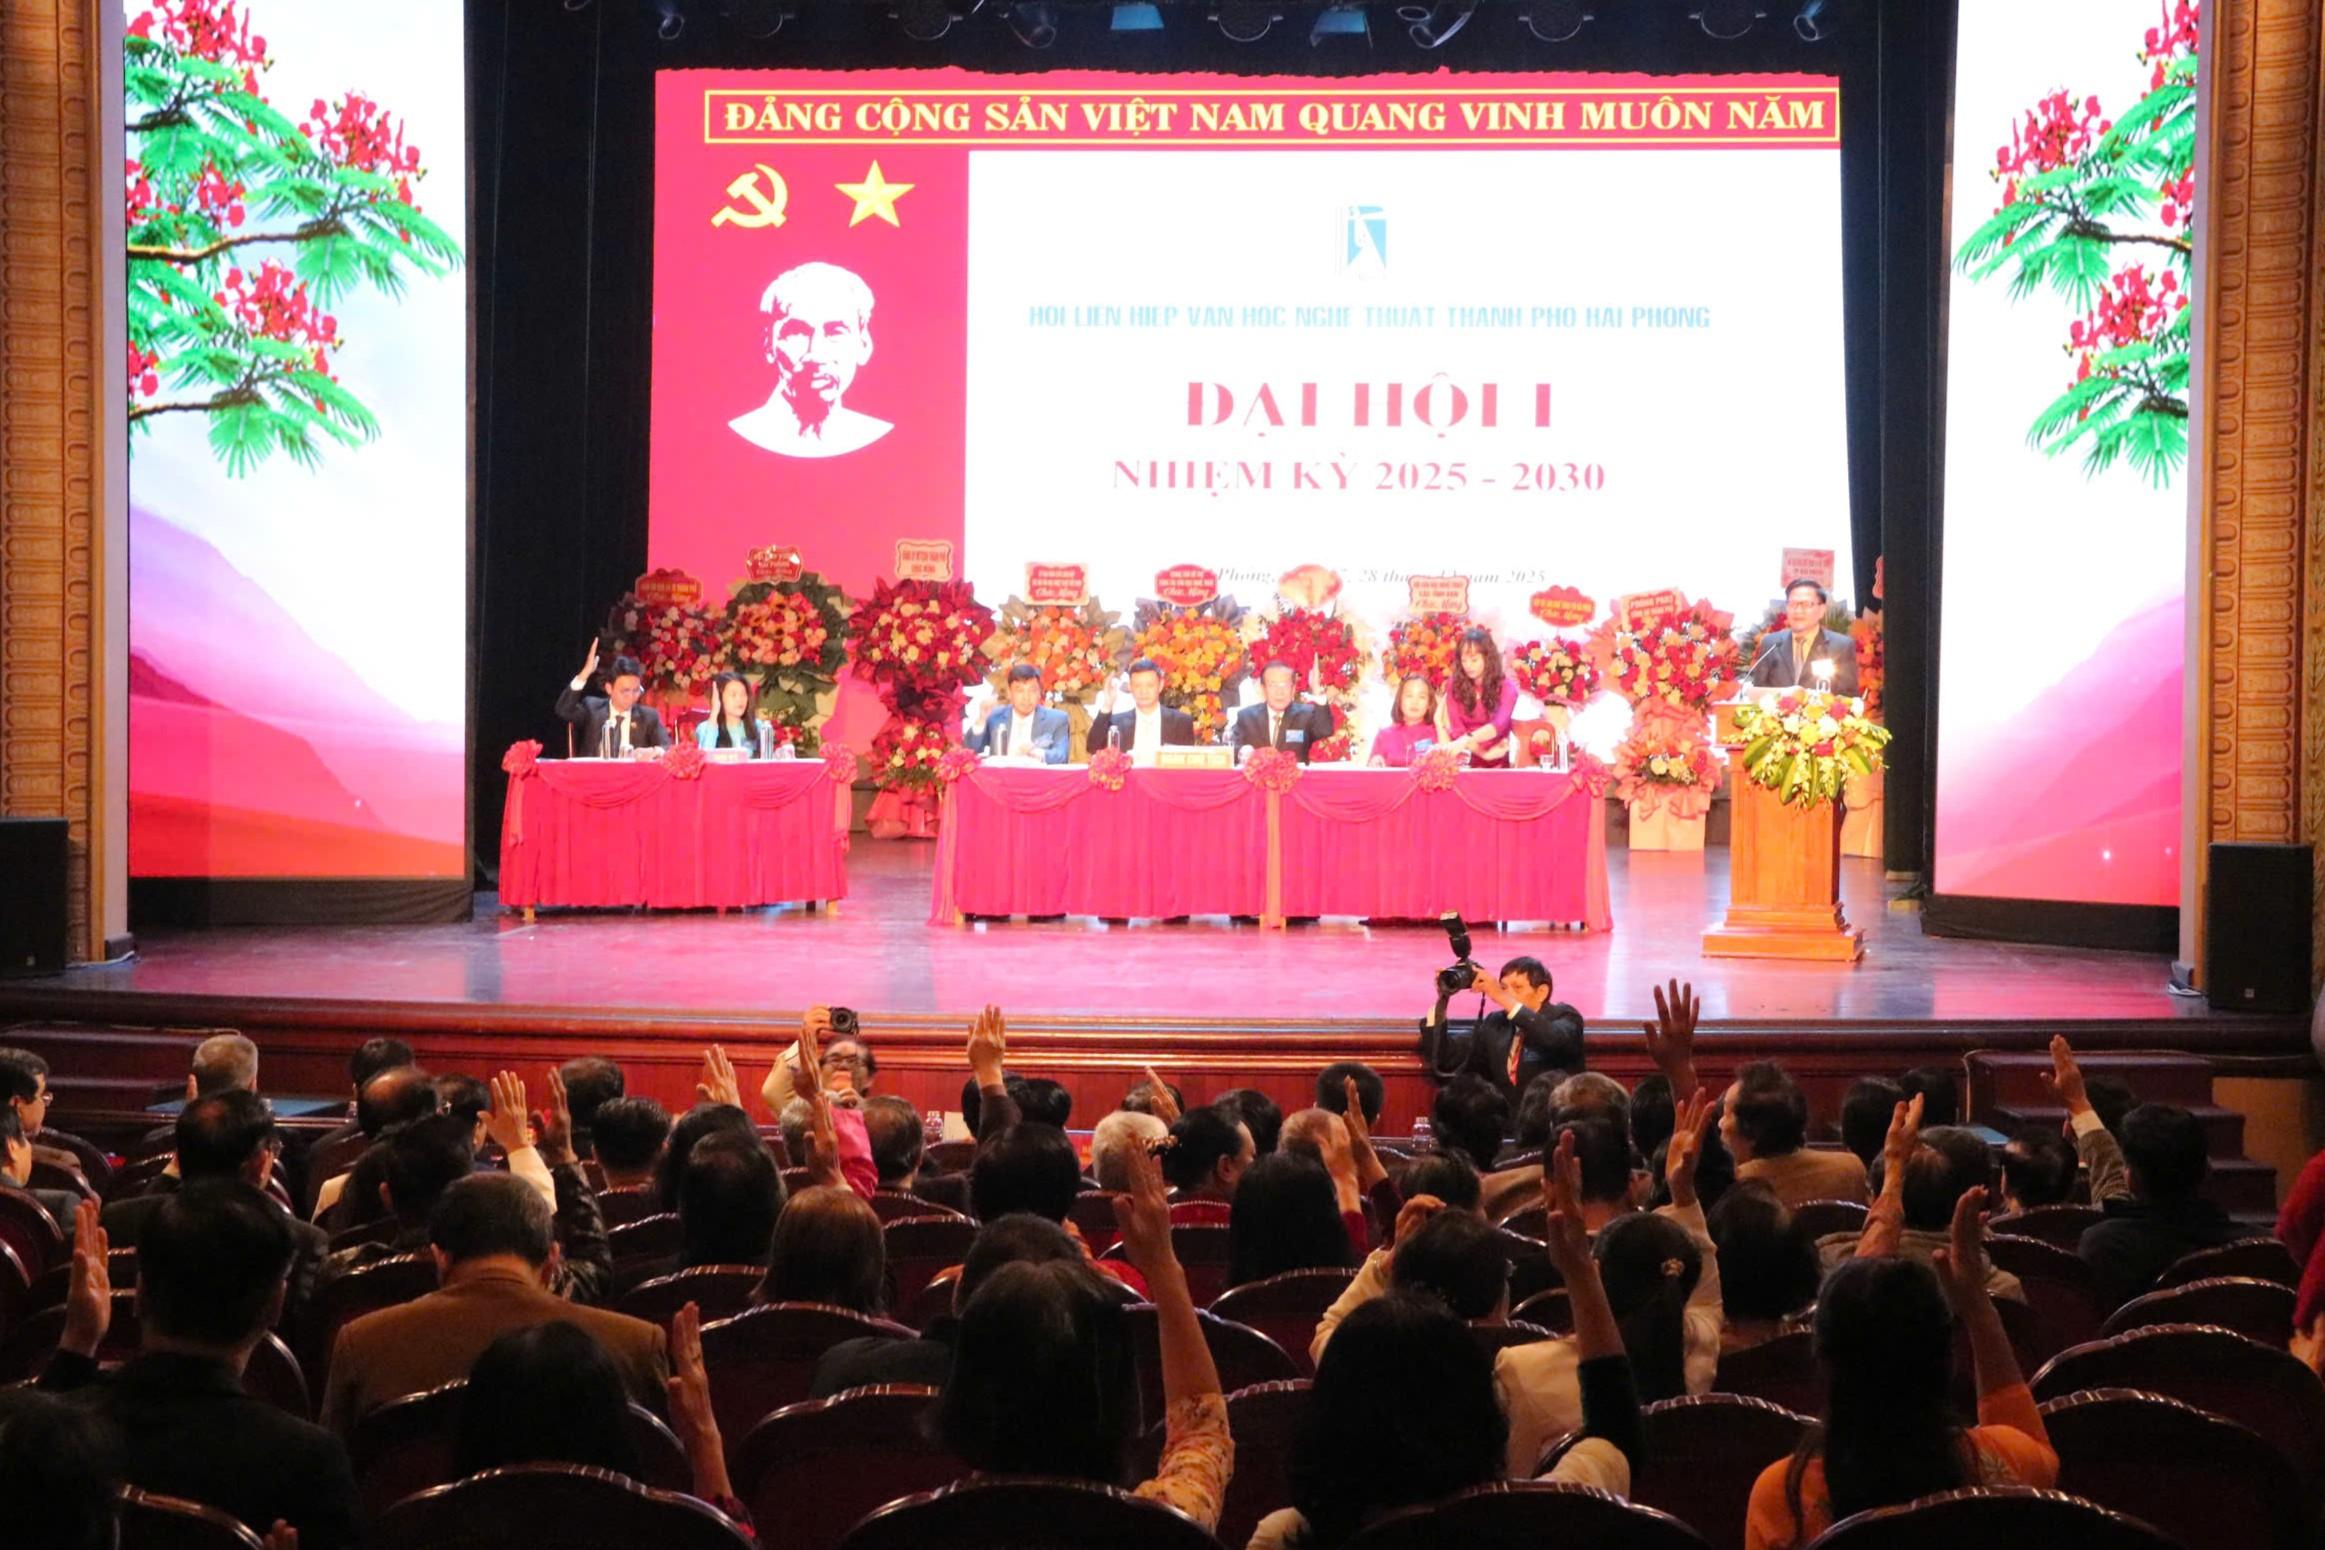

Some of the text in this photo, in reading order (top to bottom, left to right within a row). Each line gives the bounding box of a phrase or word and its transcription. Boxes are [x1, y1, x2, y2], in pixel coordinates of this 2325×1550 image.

[724, 95, 1826, 136] ĐẢNG CỘNG SẢN VIỆT NAM QUANG VINH MUÔN NĂM
[1353, 371, 1499, 439] HỘI
[1534, 382, 1552, 429] I
[1293, 451, 1358, 491] KỲ
[1375, 461, 1468, 491] 2025
[1511, 461, 1606, 492] 2030
